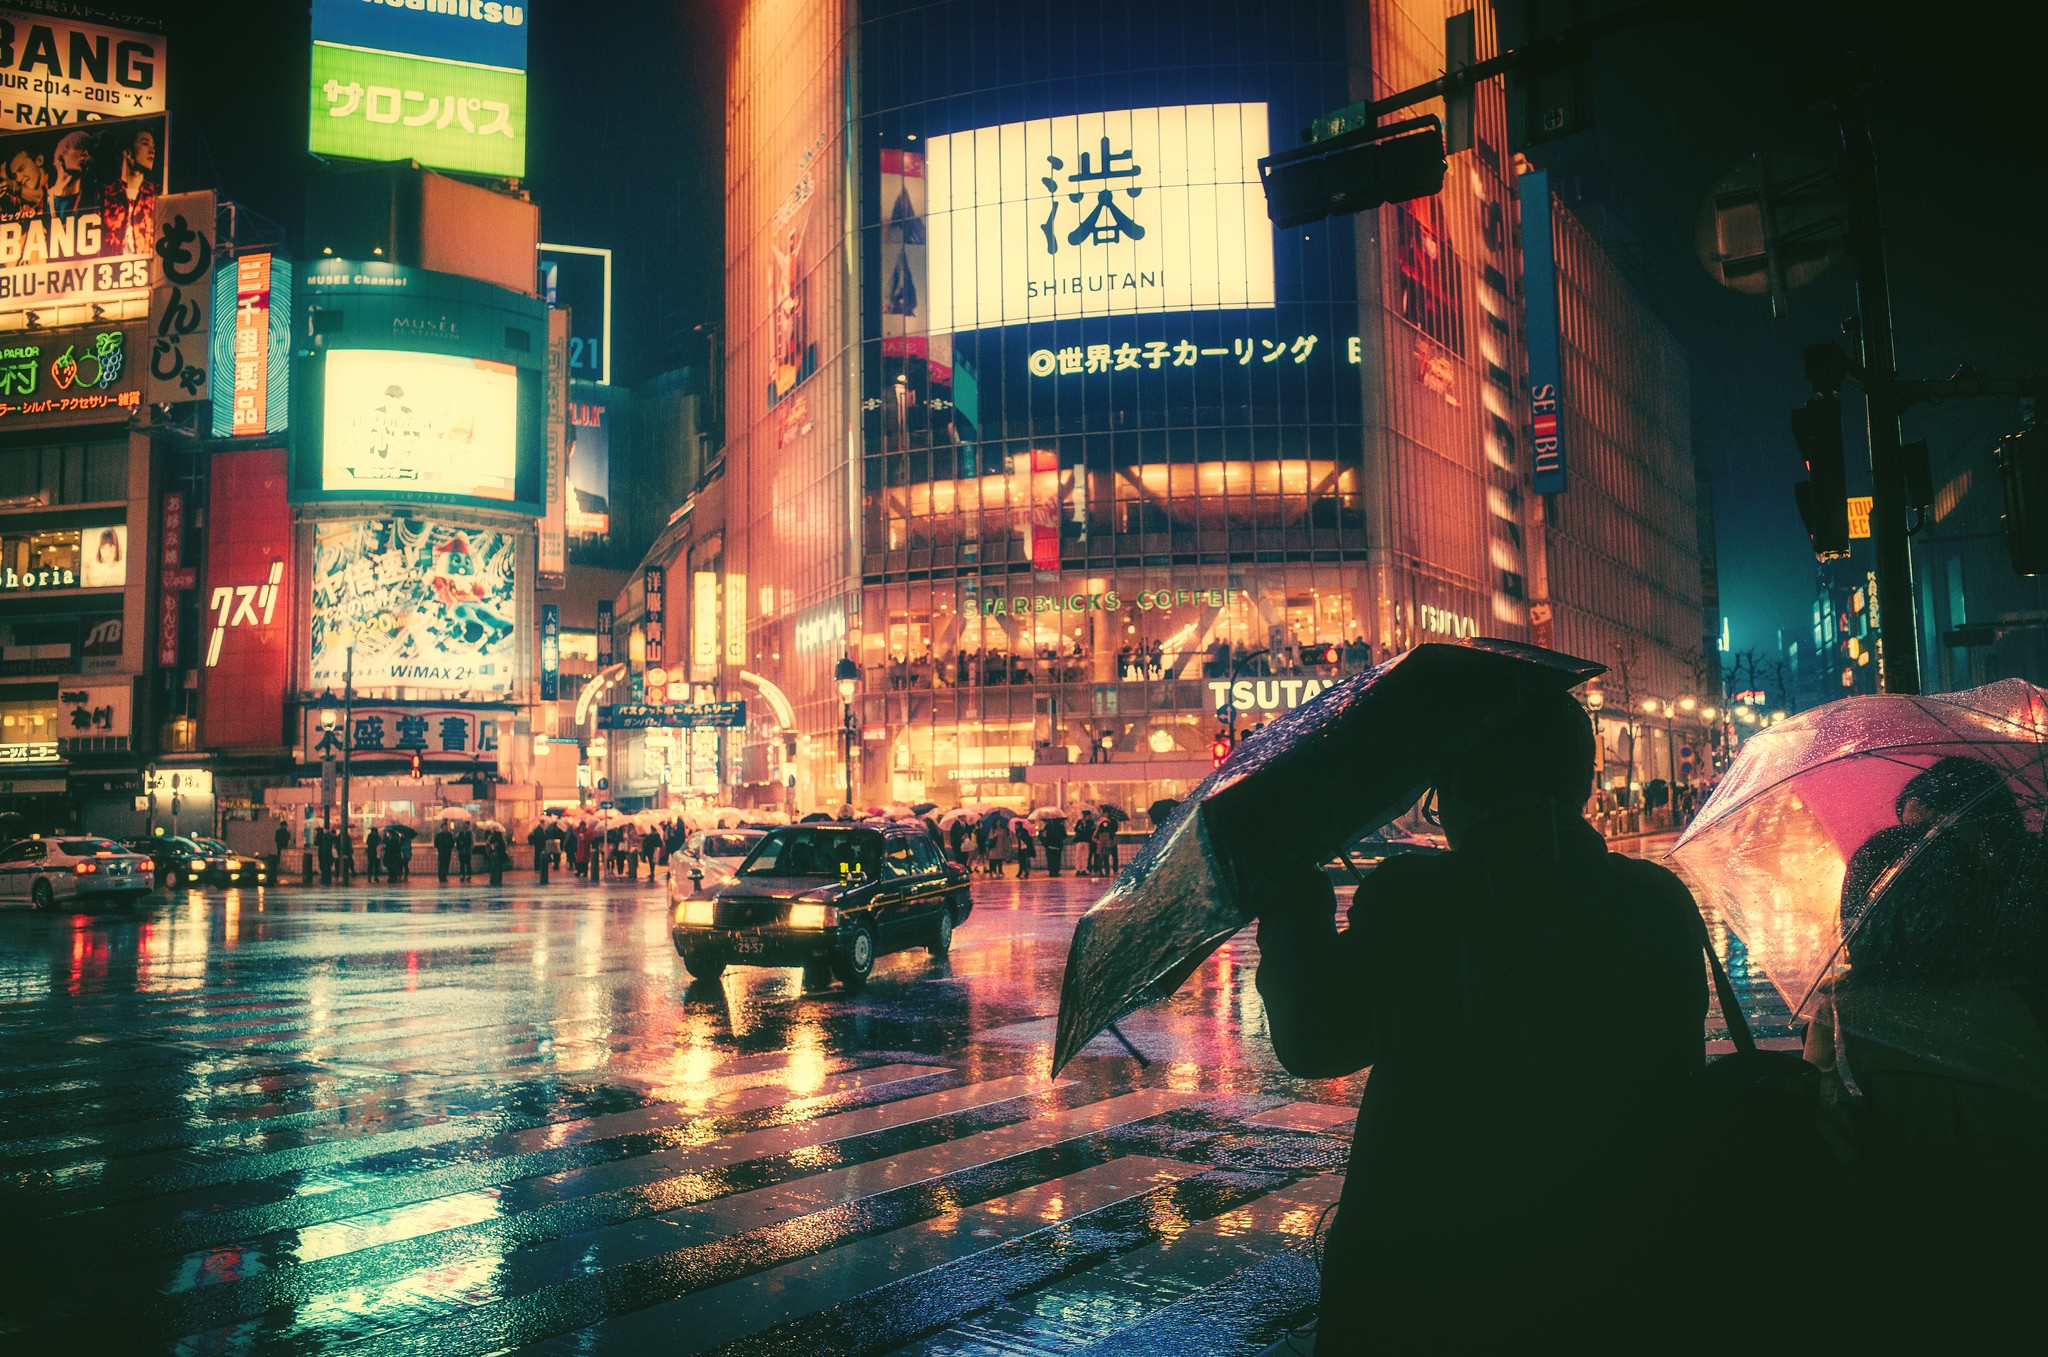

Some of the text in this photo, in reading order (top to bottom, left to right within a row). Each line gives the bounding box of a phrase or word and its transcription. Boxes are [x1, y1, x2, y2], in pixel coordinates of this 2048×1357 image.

[323, 79, 514, 139] サロンパス
[98, 260, 148, 290] 3.25
[307, 275, 407, 286] MUSEE Channel
[1027, 269, 1165, 299] SHIBUTANI
[150, 214, 211, 396] もんじゃ
[4, 346, 40, 359] PARLOR
[233, 261, 264, 425] 三千里薬品
[1532, 384, 1559, 472] SEIBU
[963, 587, 1239, 620] STARBUCKS COFFEE
[390, 665, 452, 680] WiMAX
[455, 666, 475, 681] 2+
[948, 768, 1011, 780] STARBUCKS
